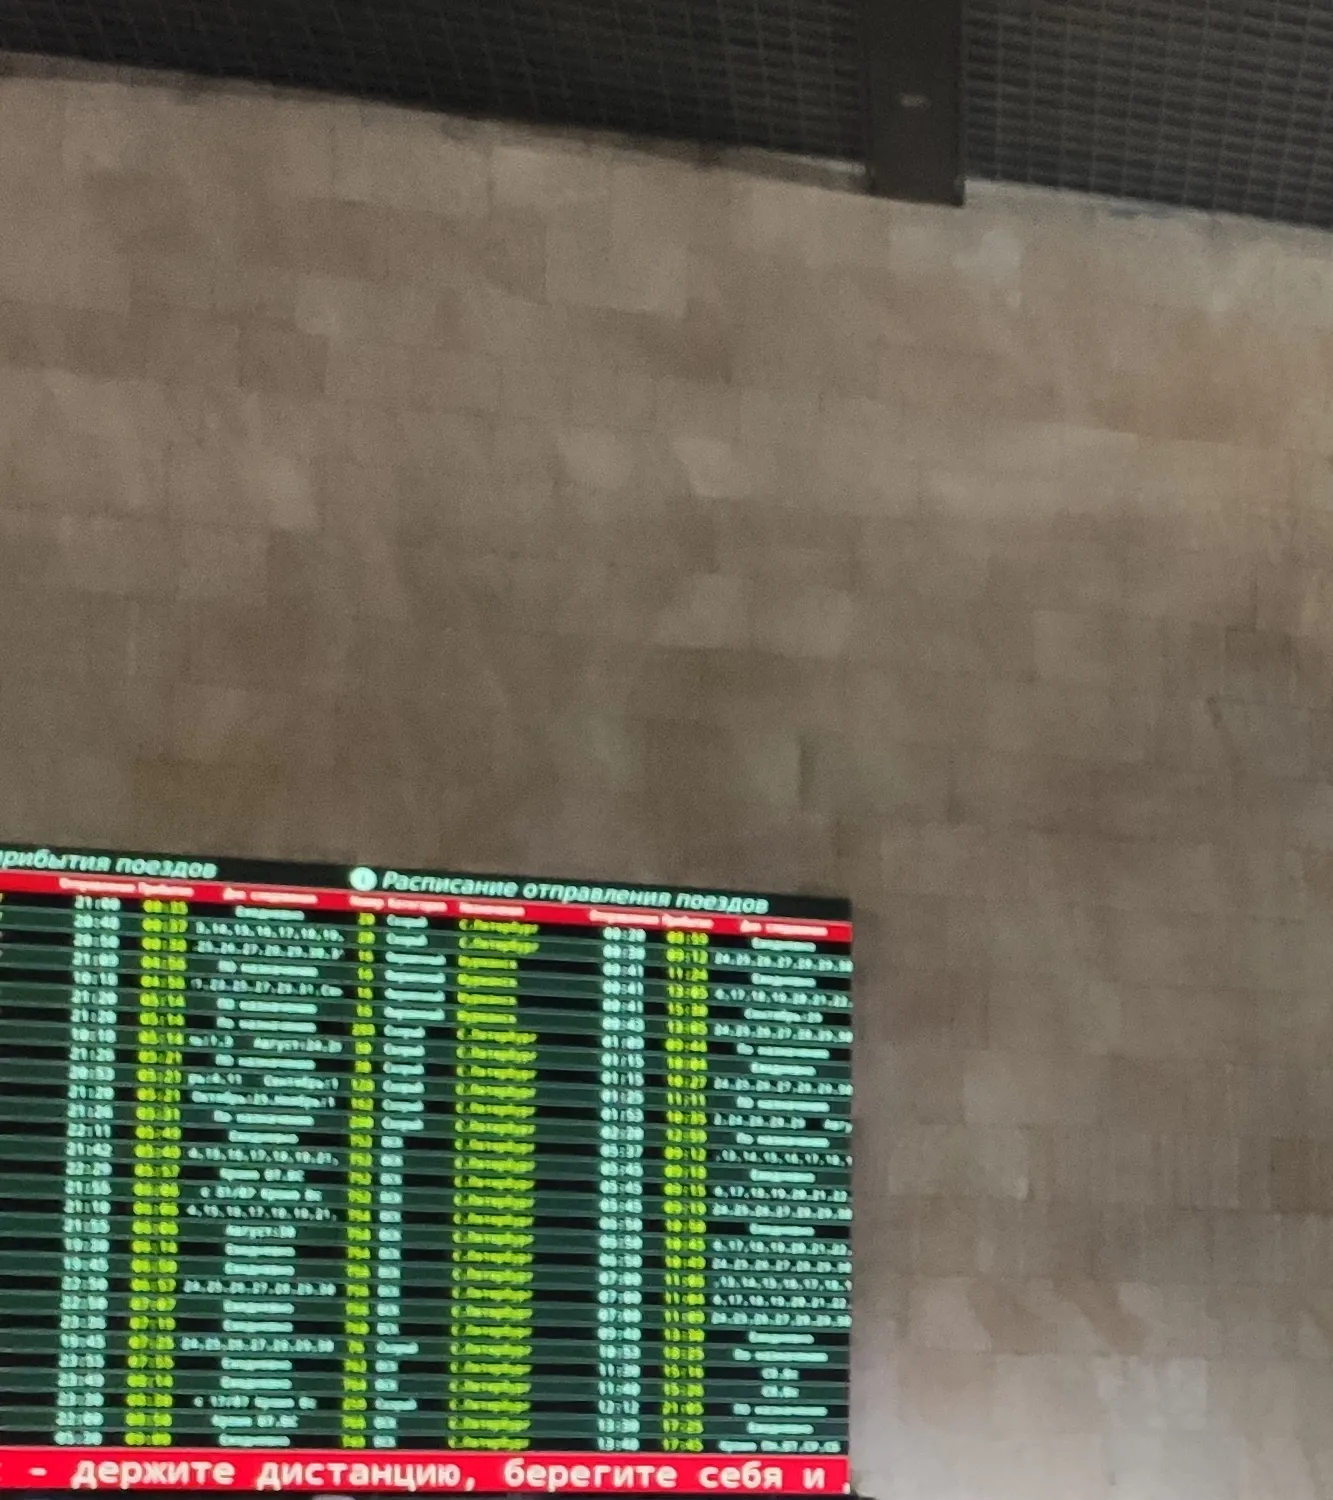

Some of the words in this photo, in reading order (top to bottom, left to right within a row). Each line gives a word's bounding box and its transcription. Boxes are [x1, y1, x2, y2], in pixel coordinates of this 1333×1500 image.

[116, 856, 218, 879] поездов
[381, 871, 519, 898] Расписание
[523, 883, 672, 910] отправления
[676, 893, 769, 915] поездов
[71, 1458, 235, 1490] держите
[256, 1462, 475, 1492] дистанцию,
[504, 1457, 677, 1493] берегите
[699, 1463, 783, 1489] себя
[804, 1467, 825, 1487] и
